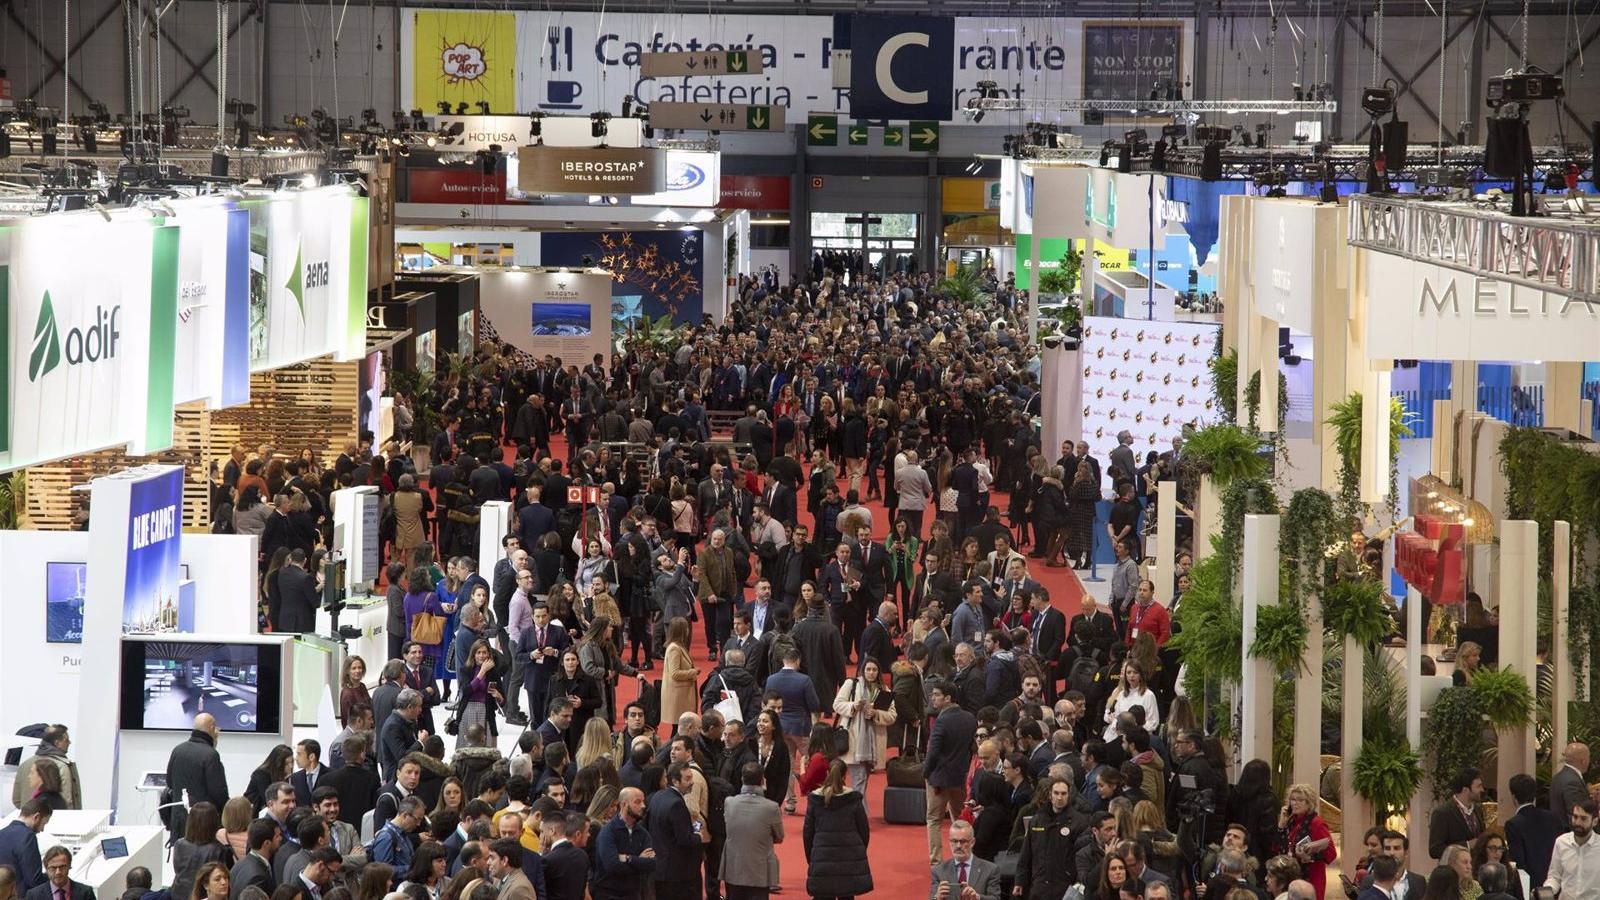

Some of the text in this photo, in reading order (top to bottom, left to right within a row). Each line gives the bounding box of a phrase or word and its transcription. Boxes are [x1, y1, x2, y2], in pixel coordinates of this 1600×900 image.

[448, 54, 471, 64] POP
[457, 63, 479, 74] ART
[875, 32, 930, 105] C
[1094, 56, 1173, 68] NON STOP
[634, 75, 792, 109] Cafeteria
[468, 132, 517, 143] HOTUSA
[561, 161, 637, 172] IBEROSTAR
[306, 261, 329, 288] aena
[65, 305, 120, 365] adif
[133, 505, 176, 550] BLUE CARPET
